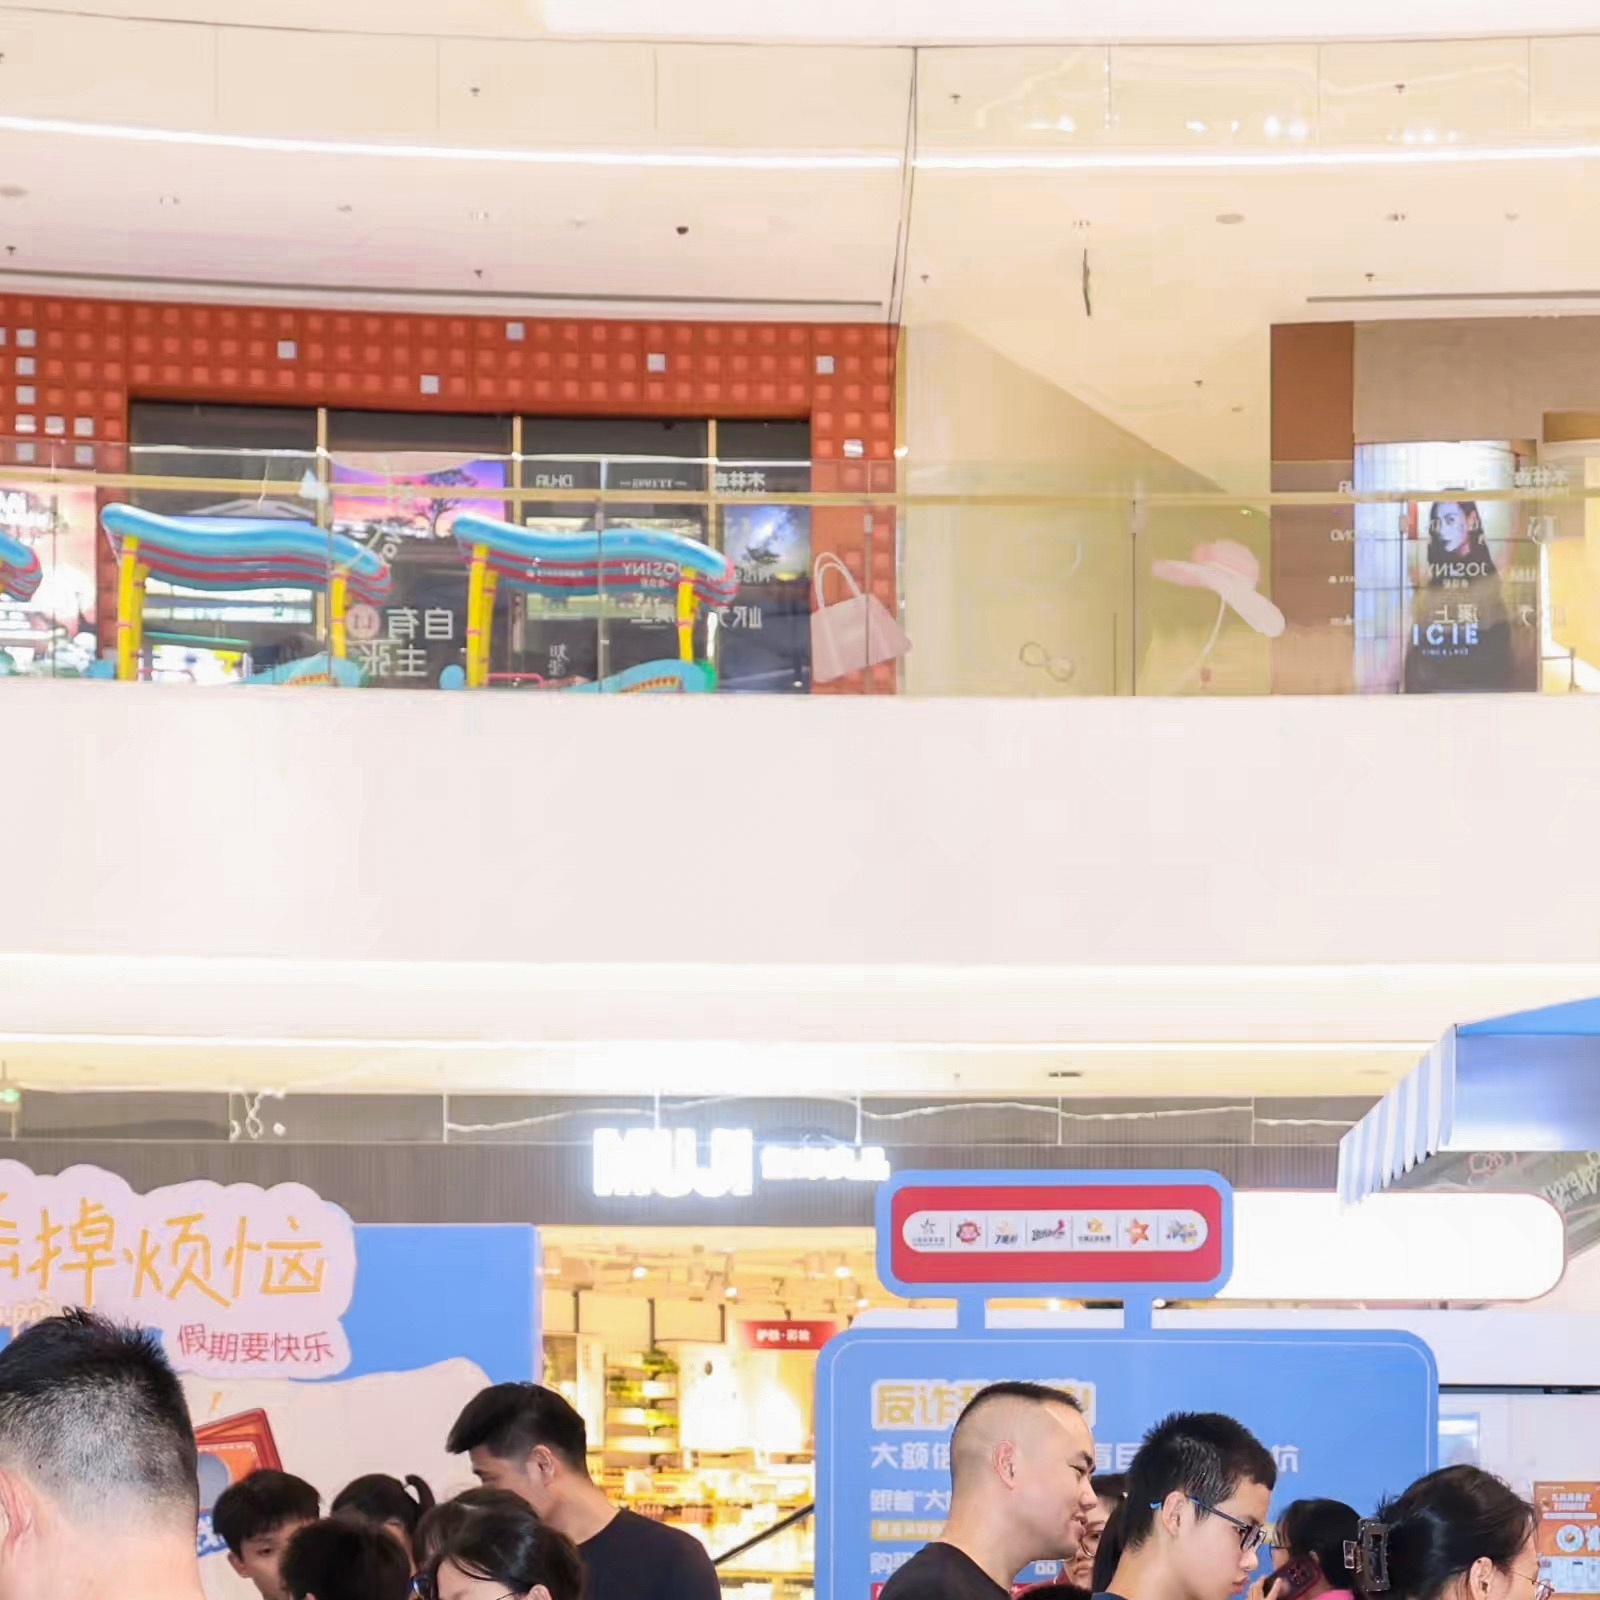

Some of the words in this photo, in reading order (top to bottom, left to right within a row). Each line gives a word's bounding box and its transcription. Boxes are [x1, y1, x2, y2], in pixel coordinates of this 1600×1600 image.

[1412, 622, 1479, 646] ICIE
[177, 1323, 334, 1364] 假期要快乐
